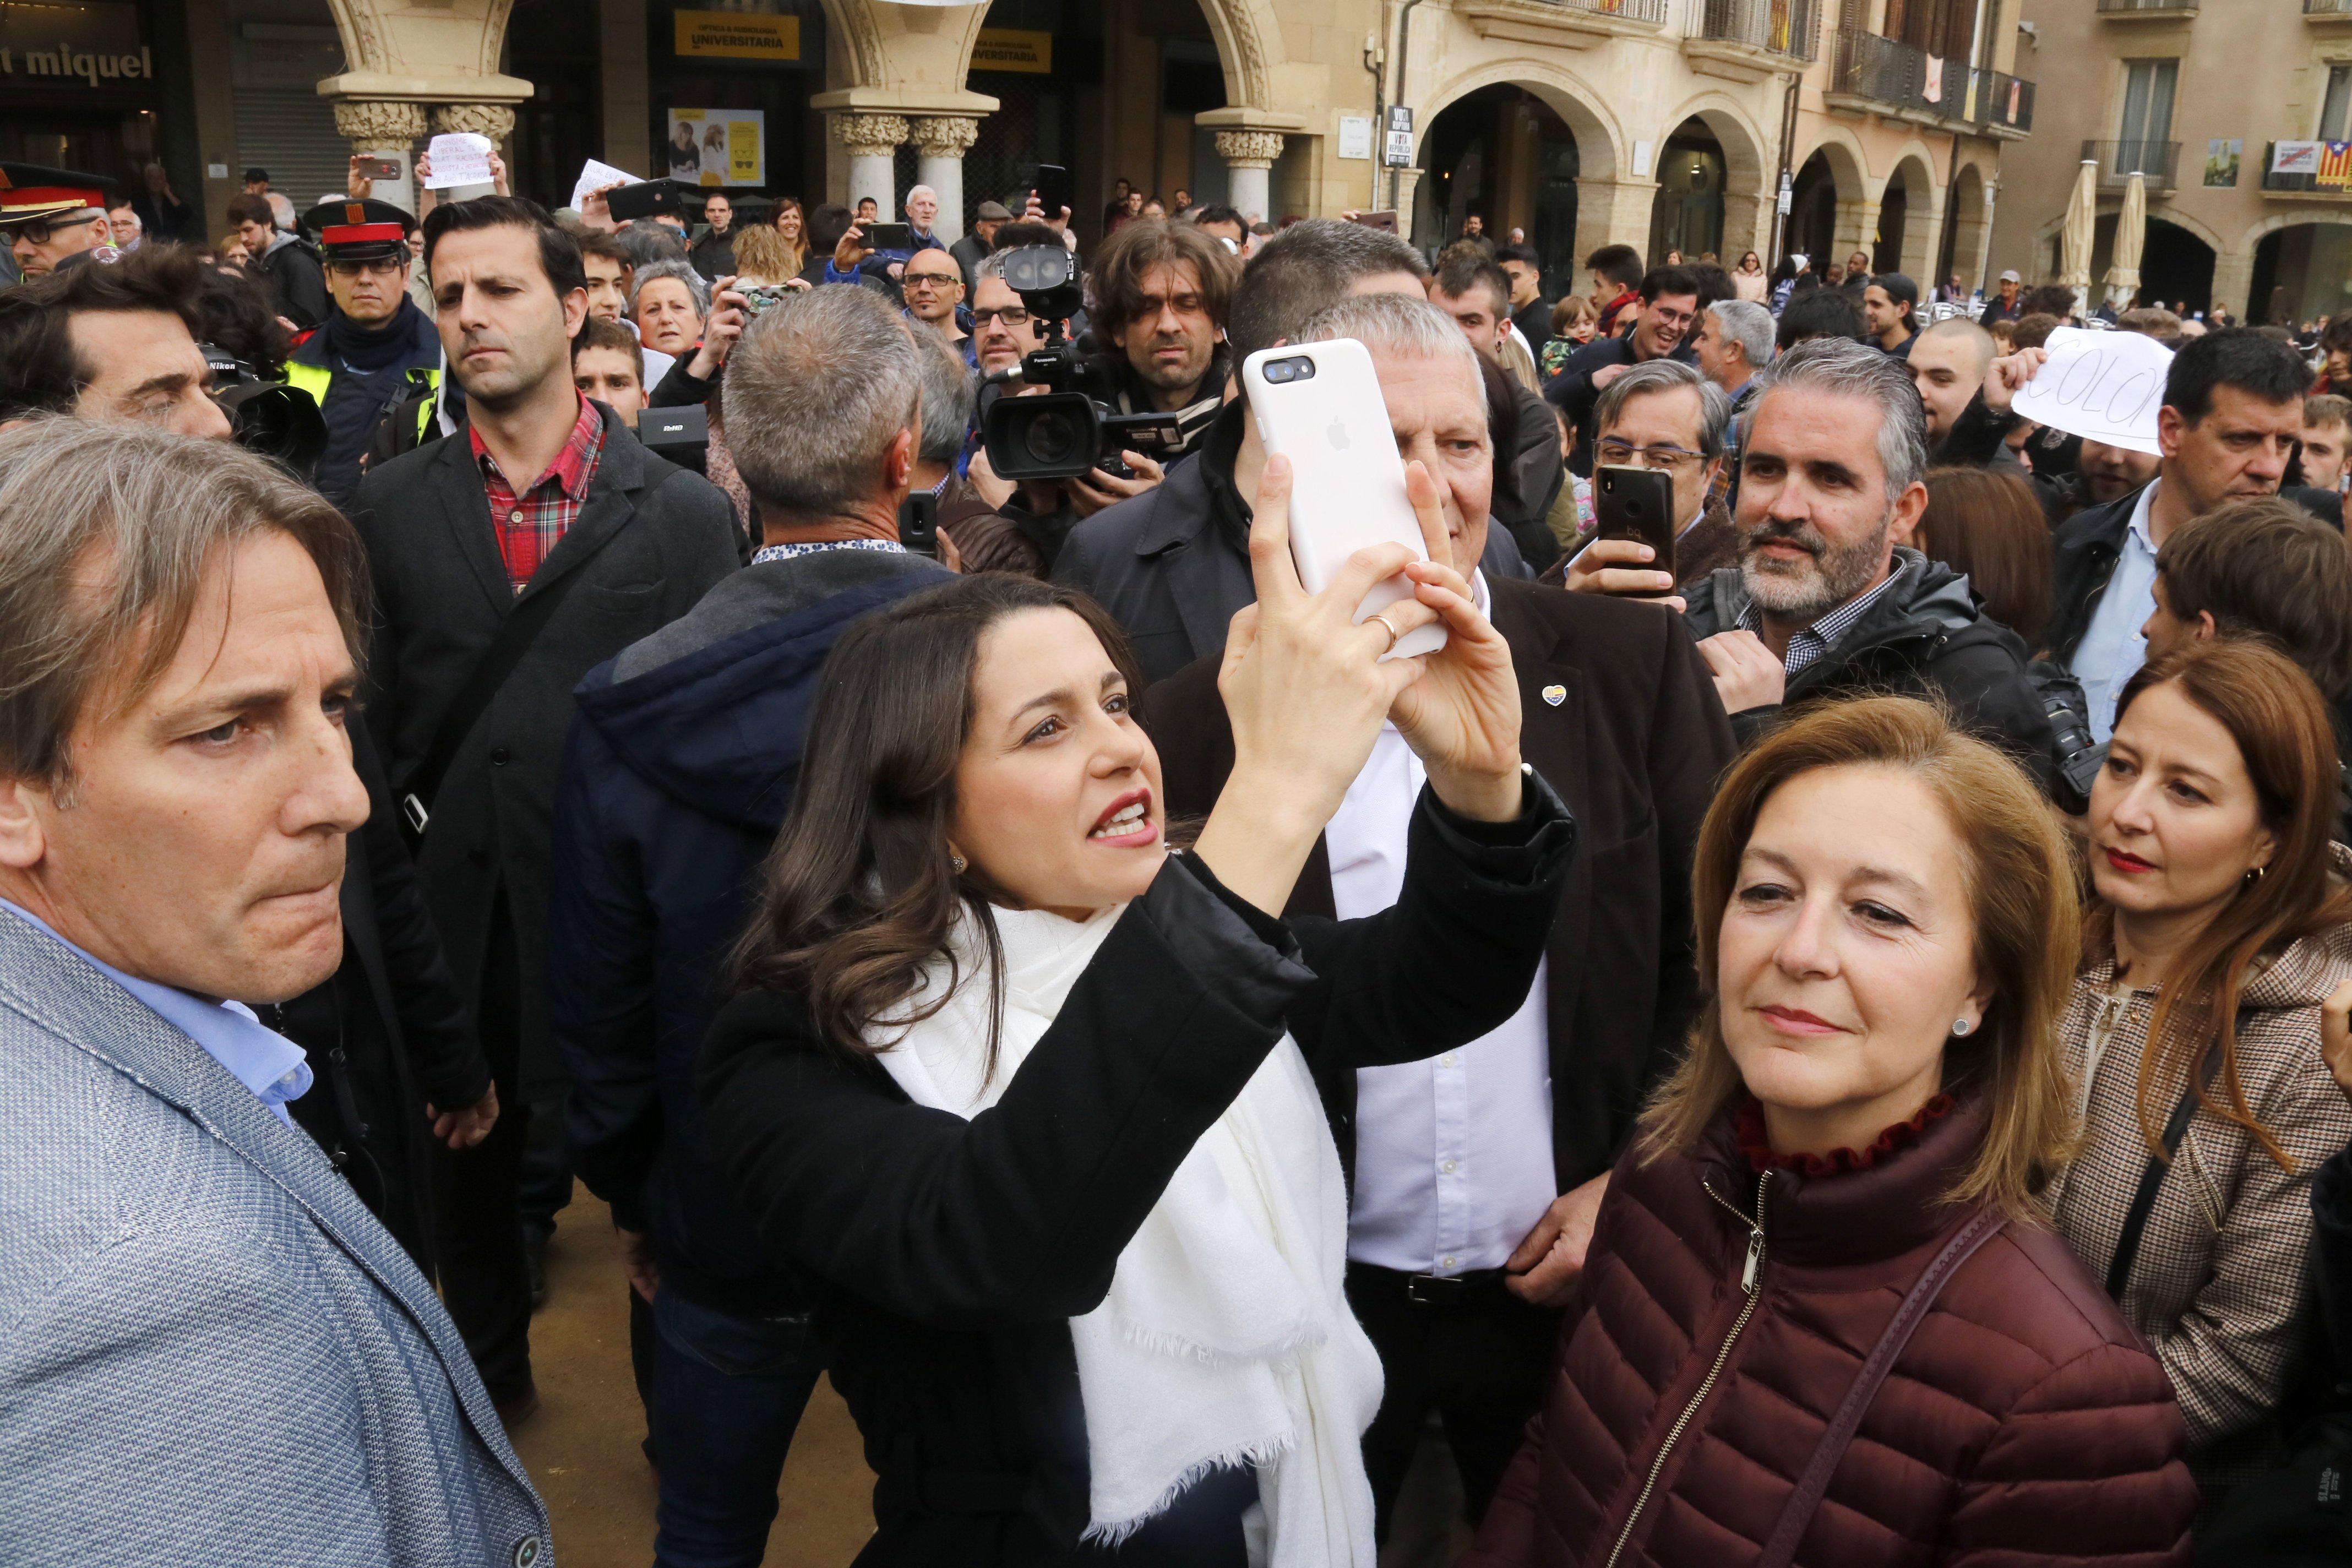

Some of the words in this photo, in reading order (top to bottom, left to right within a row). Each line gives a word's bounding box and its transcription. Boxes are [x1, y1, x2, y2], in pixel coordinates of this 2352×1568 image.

[692, 34, 783, 48] UNIVERSITARIA
[25, 42, 152, 87] miquel
[1626, 525, 1641, 540] bq
